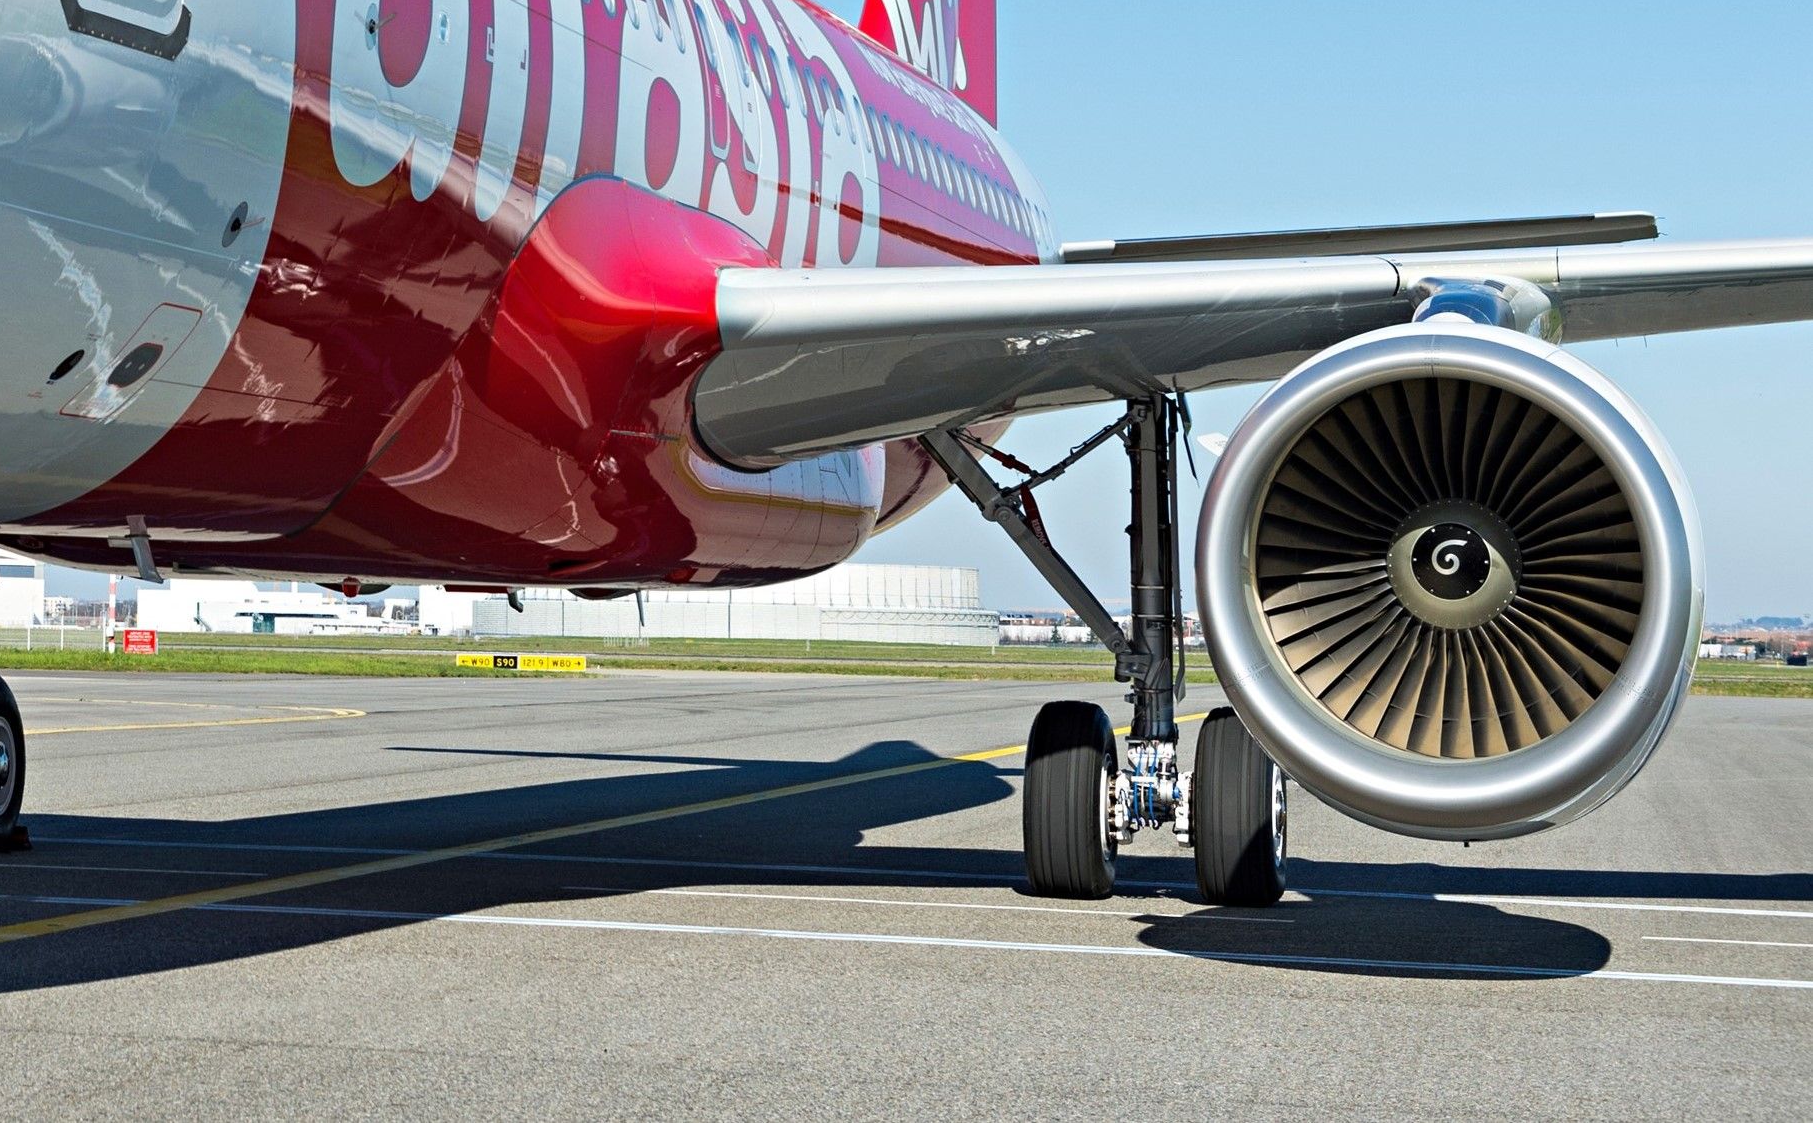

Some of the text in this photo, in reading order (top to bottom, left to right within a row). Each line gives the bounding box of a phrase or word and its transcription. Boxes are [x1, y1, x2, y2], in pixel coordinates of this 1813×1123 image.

[471, 656, 490, 666] W90
[496, 658, 515, 667] S90
[552, 659, 571, 668] W80
